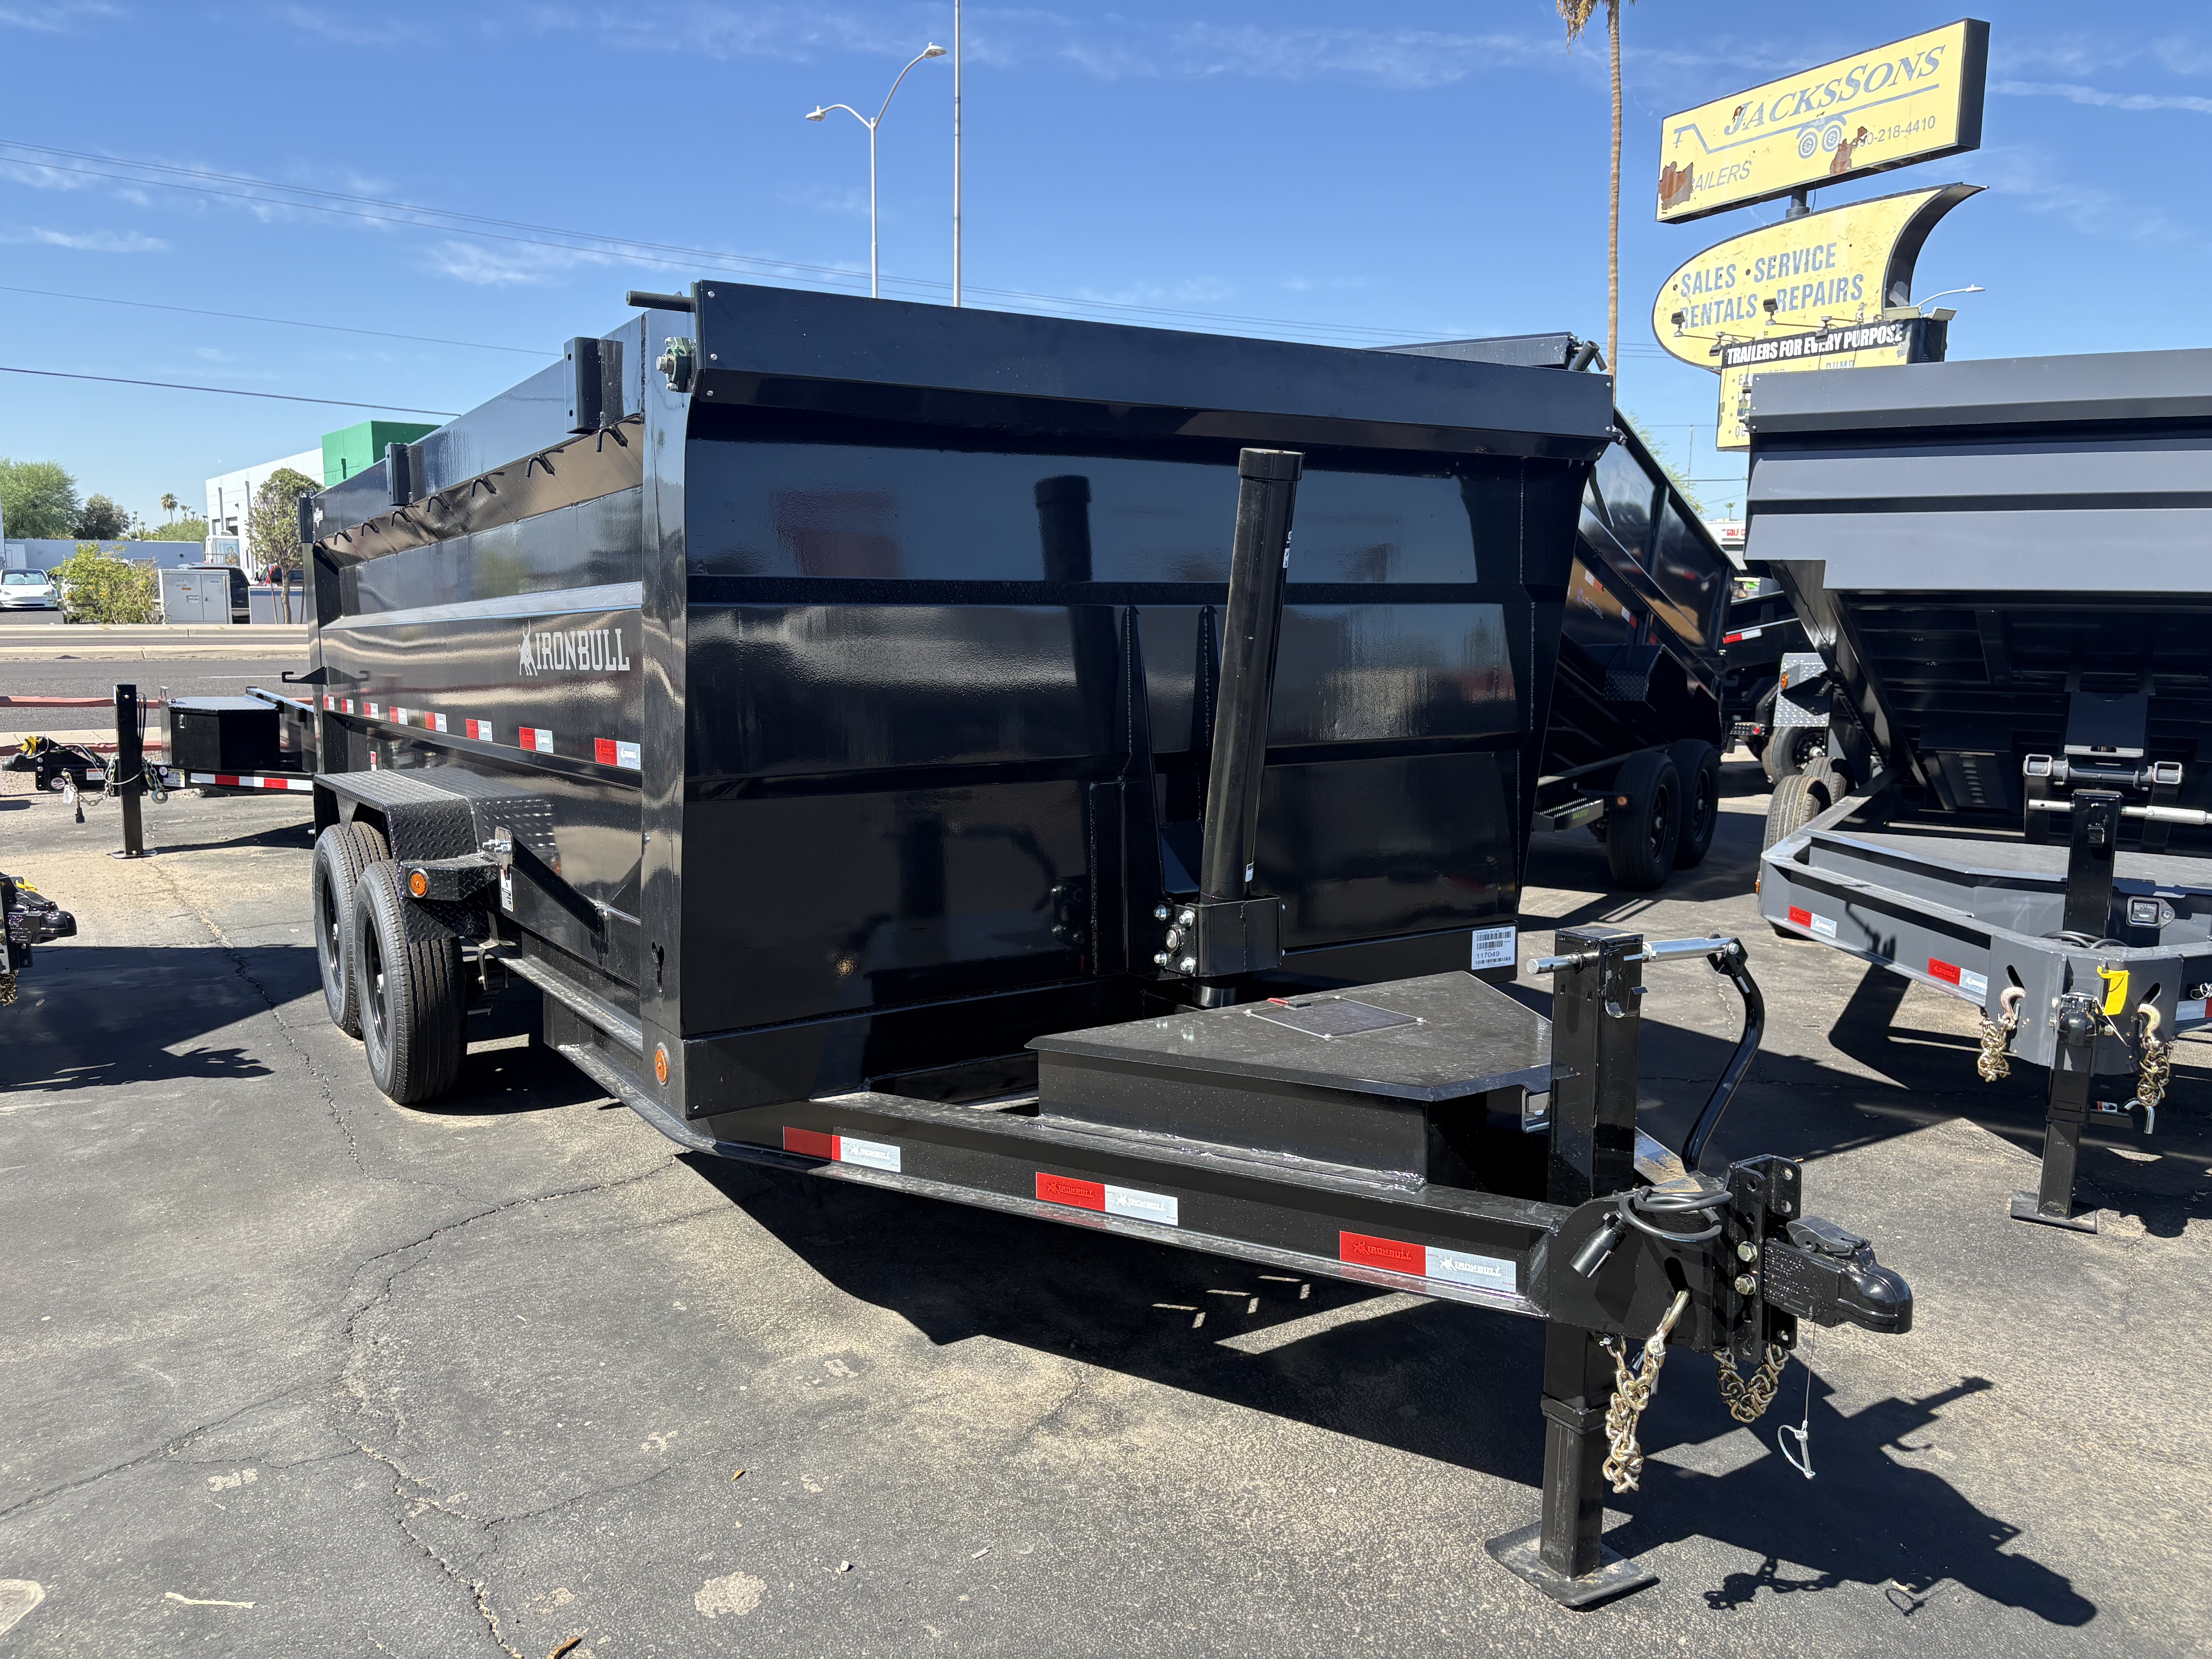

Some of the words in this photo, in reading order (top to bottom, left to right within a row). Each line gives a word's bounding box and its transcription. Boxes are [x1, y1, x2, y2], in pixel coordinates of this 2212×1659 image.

[1691, 160, 1752, 193] AILERS
[1681, 264, 1736, 297] SALES
[1754, 243, 1837, 283] SERVICE
[1776, 274, 1864, 313] REPAIRS
[1727, 342, 1778, 364] TRAILERS
[1779, 338, 1802, 357] FOR
[1843, 324, 1903, 349] PURPOSE
[535, 629, 630, 671] IRONBULL
[1058, 1185, 1094, 1199] IRONBULL
[1367, 1245, 1412, 1261] IRONBULL
[1455, 1261, 1502, 1277] IRONBULL
